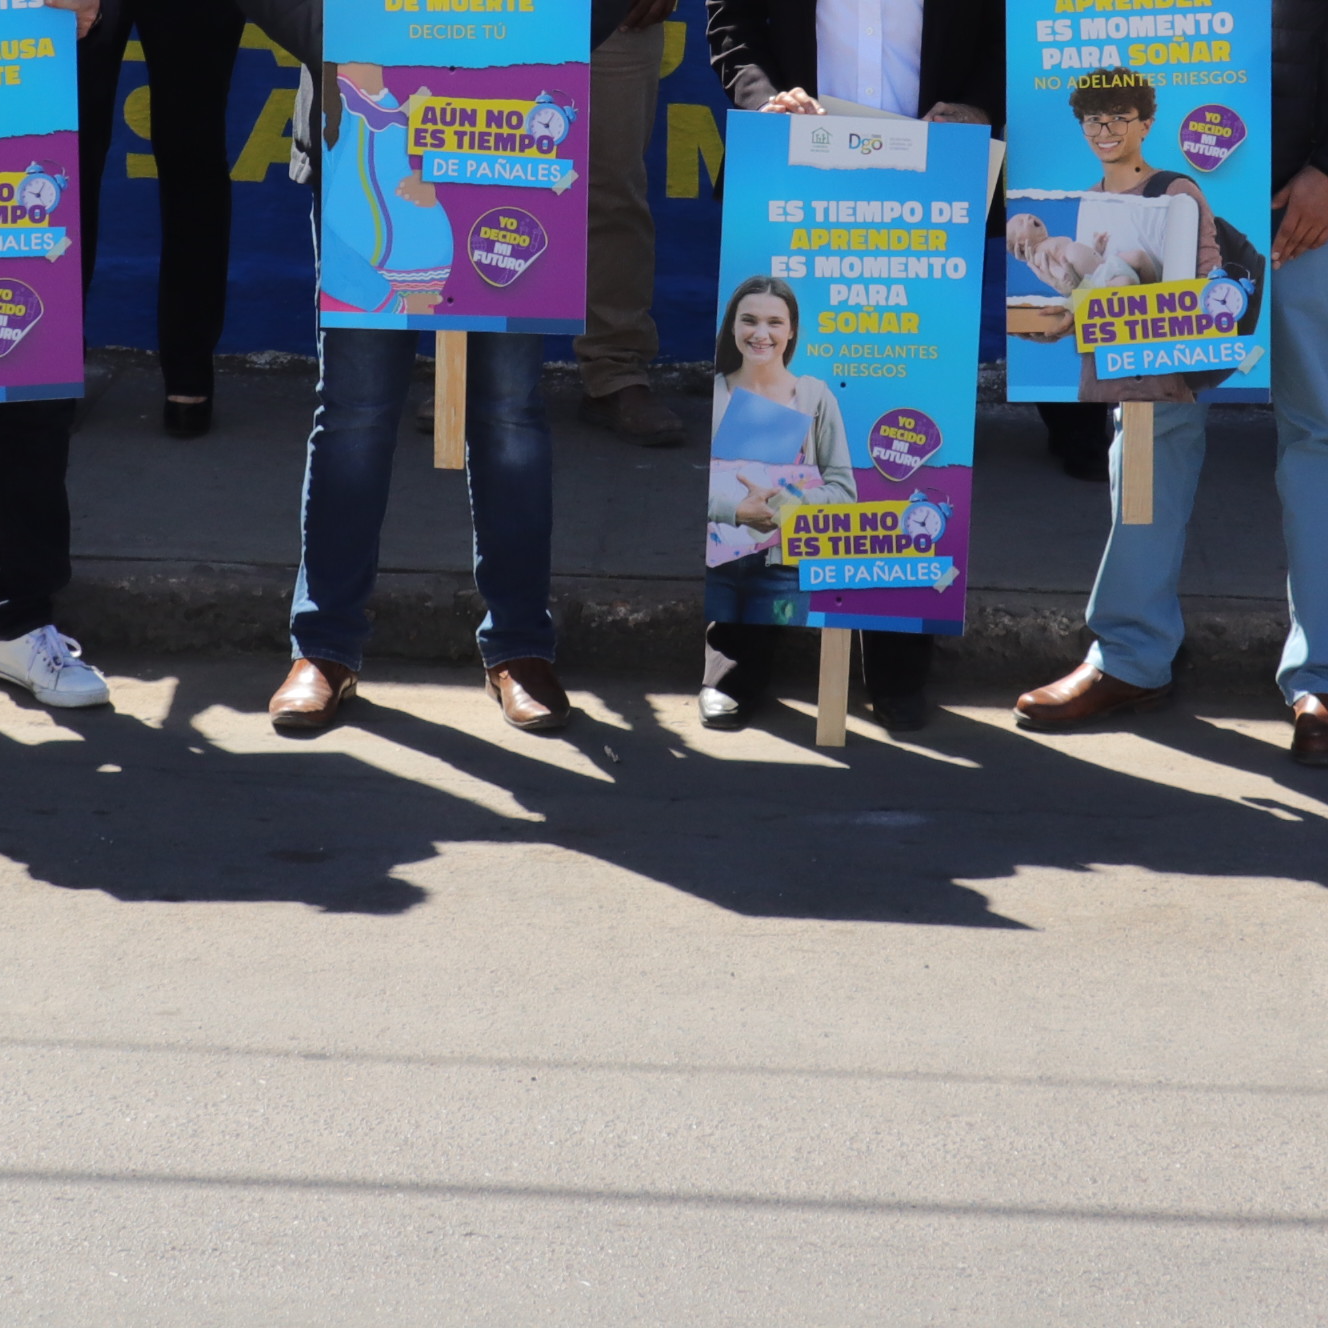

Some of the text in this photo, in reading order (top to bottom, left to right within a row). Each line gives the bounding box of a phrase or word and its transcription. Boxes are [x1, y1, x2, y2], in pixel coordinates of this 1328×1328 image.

[1036, 12, 1233, 42] ES MOMENTO
[1042, 36, 1231, 70] PARA SOÑAR
[1204, 111, 1221, 124] YO
[1188, 122, 1232, 137] DECIDO
[1182, 142, 1228, 158] FUTURO
[1200, 135, 1217, 147] MI
[499, 215, 518, 229] YO
[479, 227, 530, 247] DECIDO
[494, 243, 512, 255] MI
[473, 252, 525, 271] FUTURO
[770, 255, 967, 279] ES MOMENTO
[829, 283, 909, 306] PARA
[817, 305, 920, 335] SOÑAR
[793, 509, 899, 534] AÚN NO
[786, 533, 933, 558] ES TIEMPO
